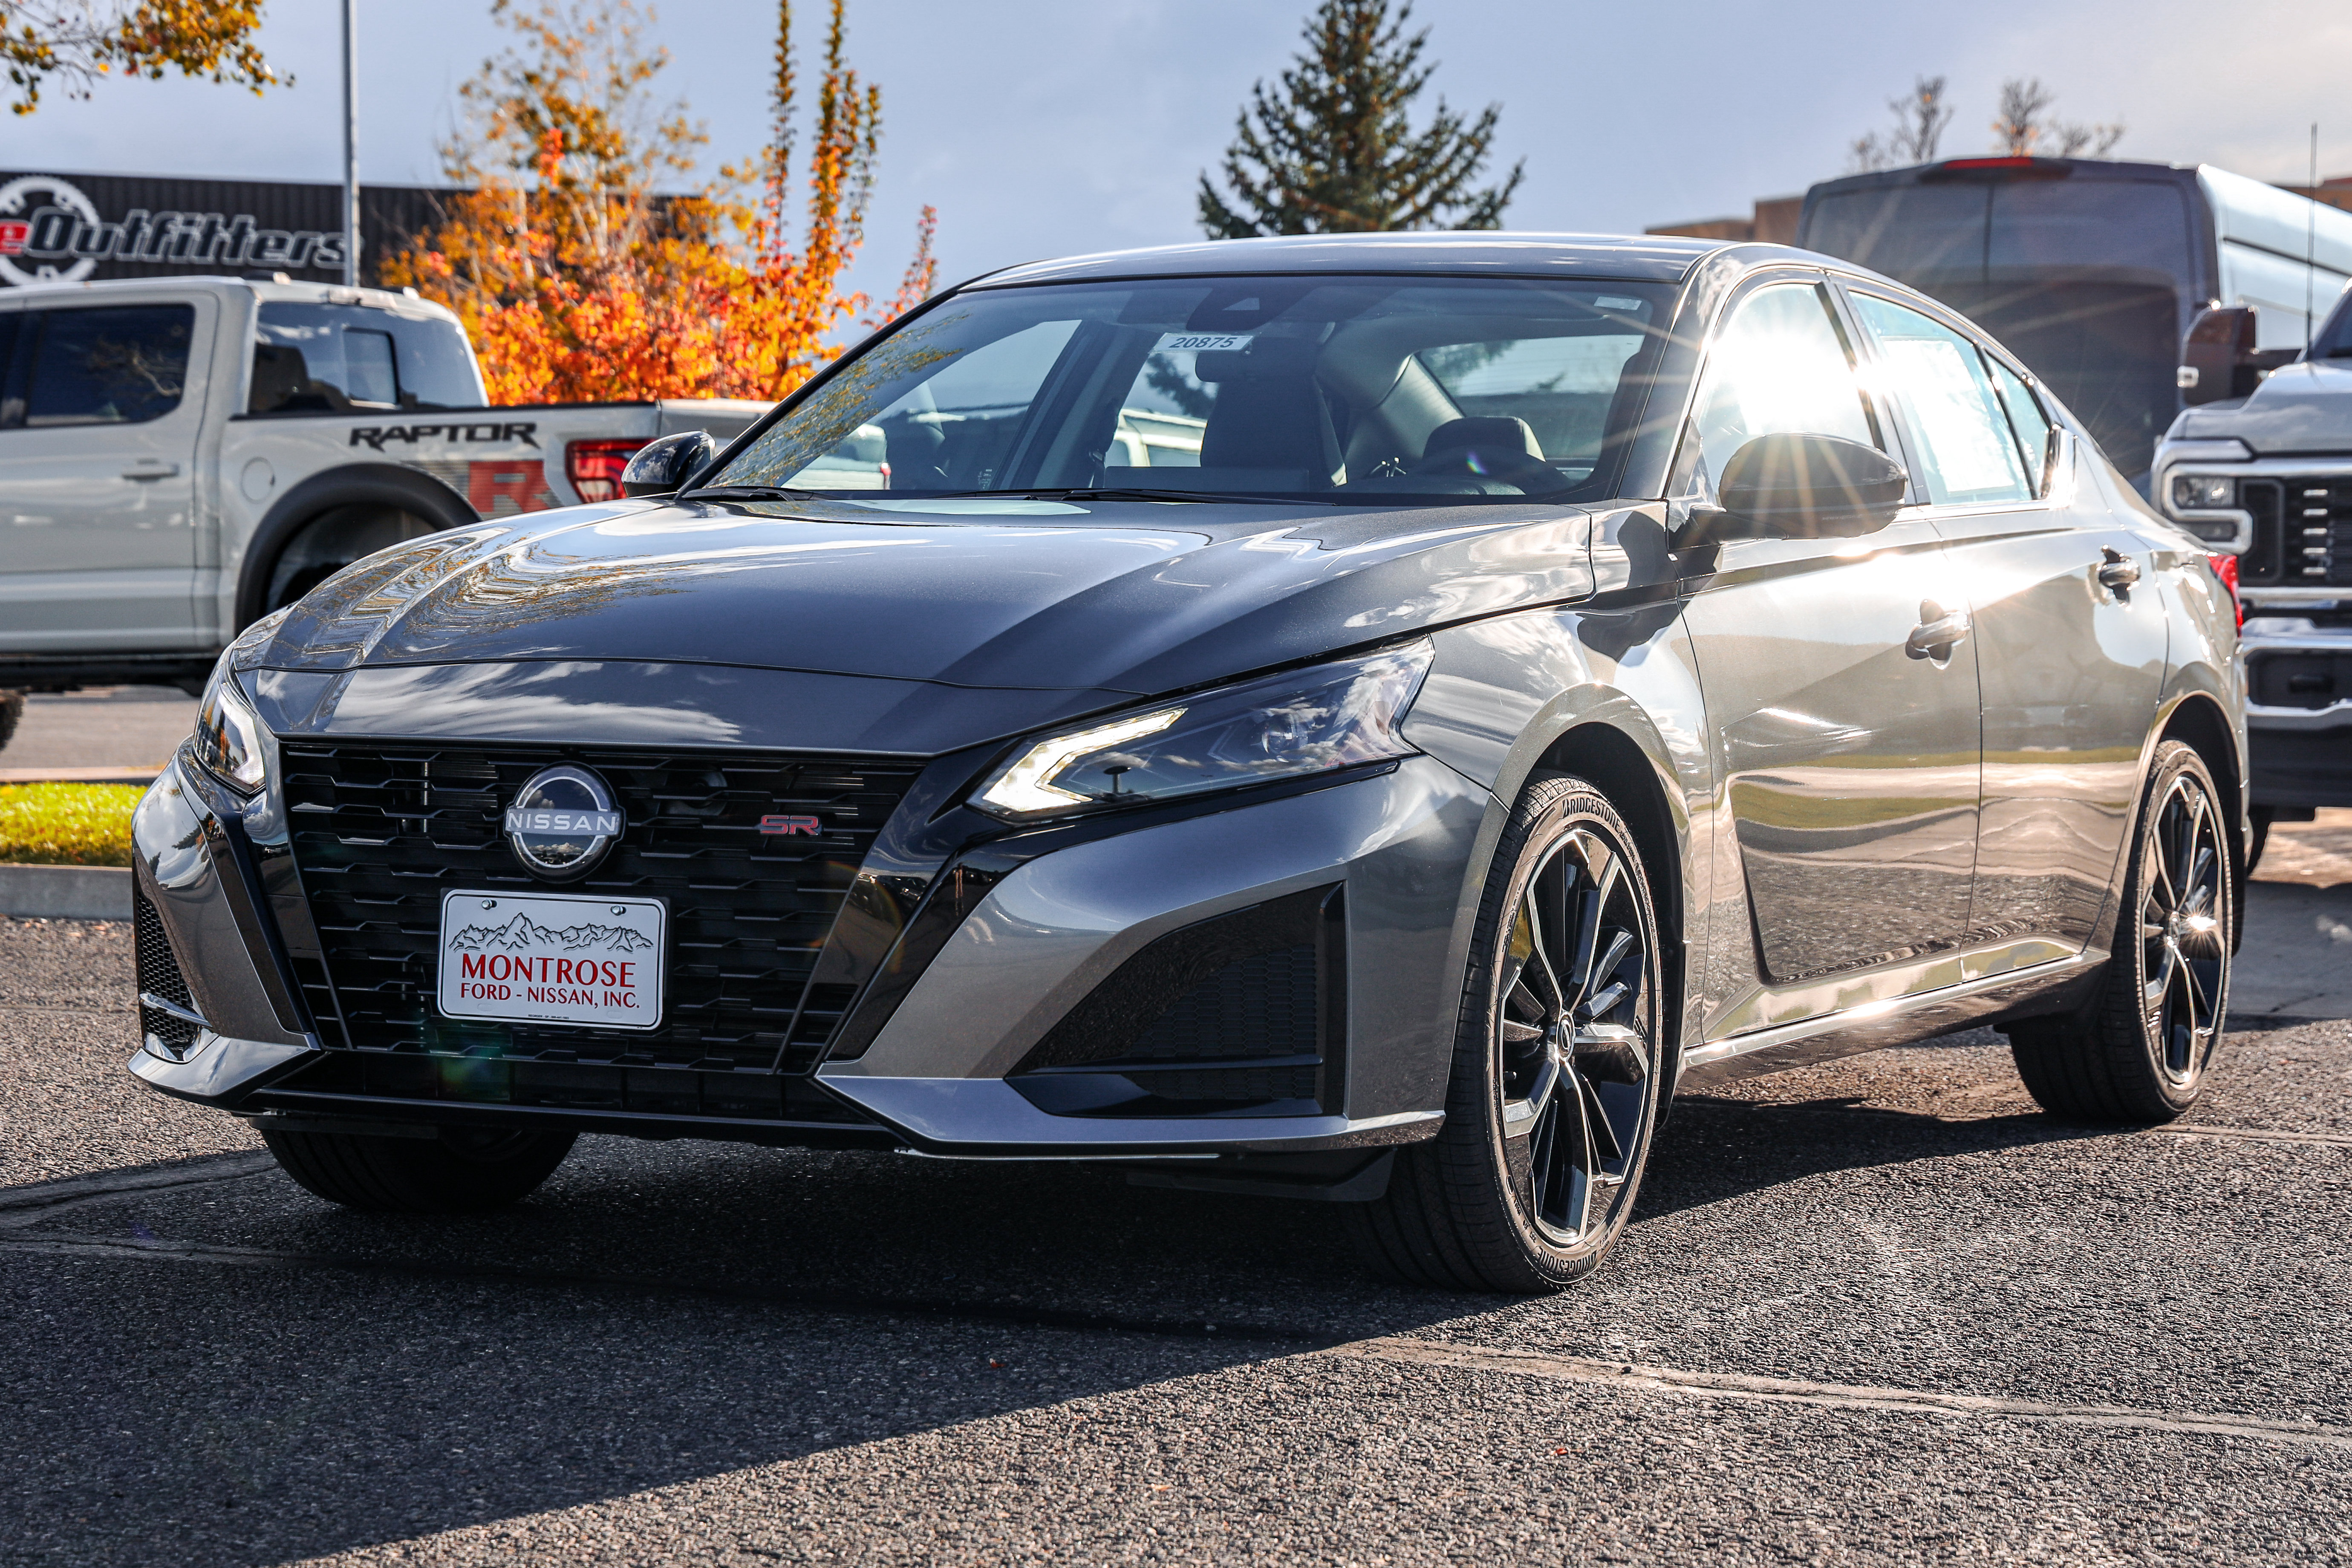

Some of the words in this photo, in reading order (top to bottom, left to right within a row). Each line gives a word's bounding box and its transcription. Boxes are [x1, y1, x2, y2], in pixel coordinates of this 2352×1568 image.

[1169, 337, 1238, 348] 20875
[349, 422, 542, 453] RAPTOR
[508, 813, 616, 831] NISSAN
[760, 815, 819, 835] SR
[1562, 797, 1621, 833] BRIDGESTONE
[462, 953, 636, 988] MONTROSE
[461, 982, 511, 1000] FORD
[528, 986, 598, 1009] NISSAN,
[604, 991, 640, 1008] INC.
[1537, 1246, 1597, 1277] BRIDGESTONE
